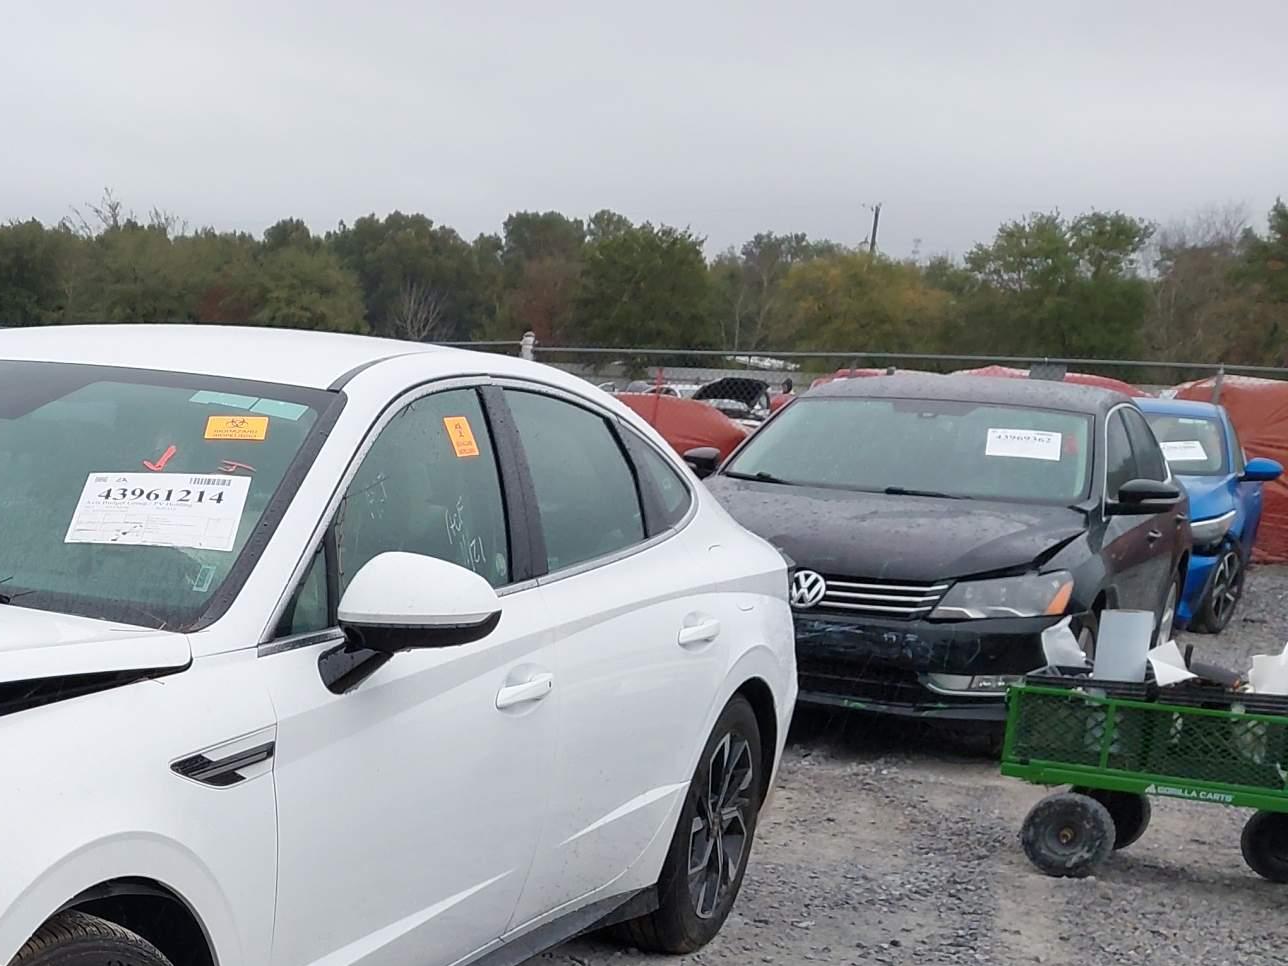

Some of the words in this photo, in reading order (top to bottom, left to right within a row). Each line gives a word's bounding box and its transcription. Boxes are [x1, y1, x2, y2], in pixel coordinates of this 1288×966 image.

[98, 487, 224, 504] 43961214
[1157, 786, 1197, 798] GORILLA
[1199, 791, 1233, 802] CARTS
